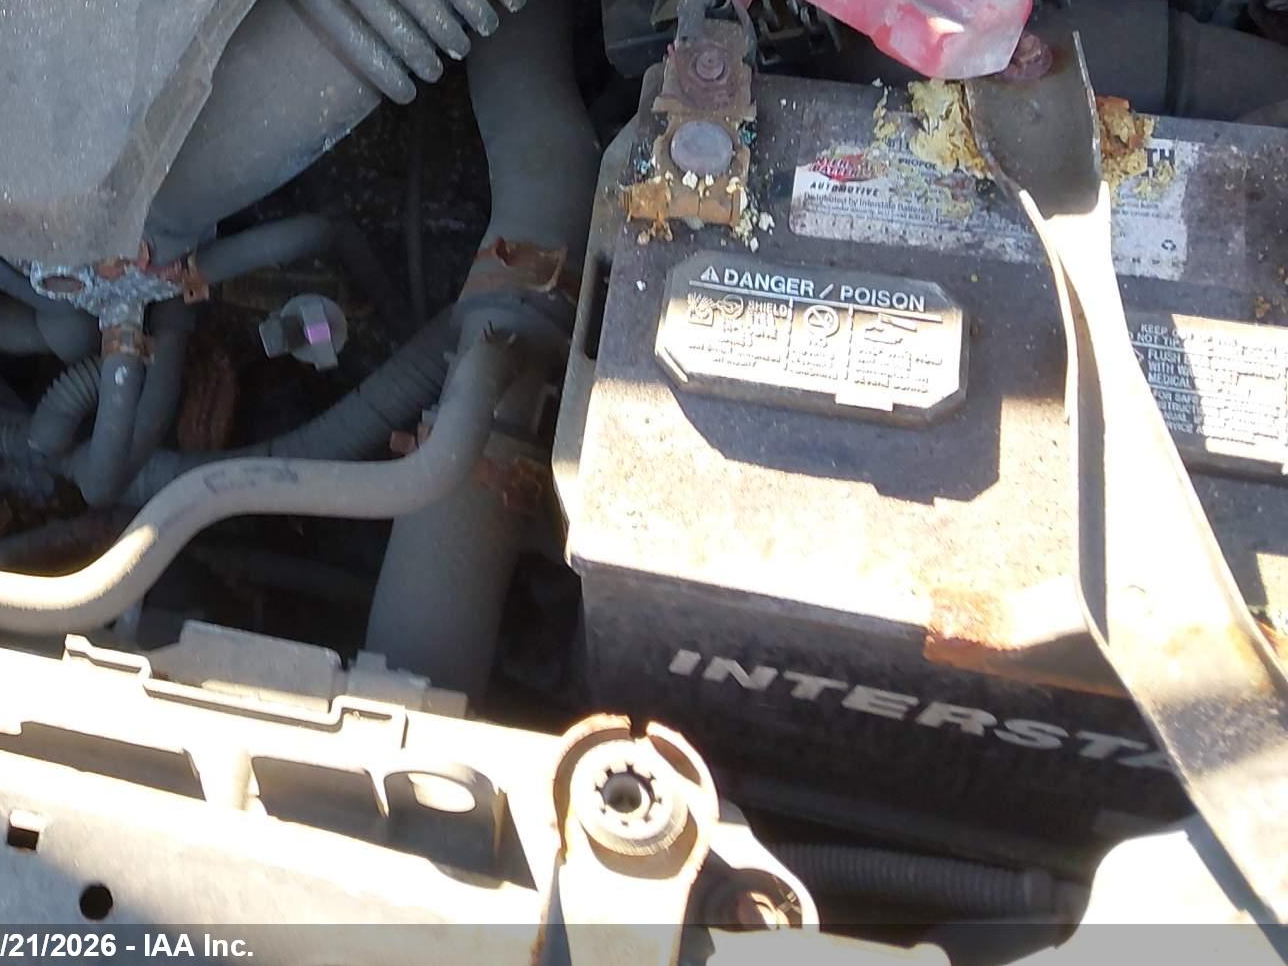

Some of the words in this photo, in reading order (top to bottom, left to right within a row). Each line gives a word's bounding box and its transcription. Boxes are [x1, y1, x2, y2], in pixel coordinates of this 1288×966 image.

[810, 180, 879, 197] AUTOMOTIVE
[724, 268, 815, 298] DANGER
[840, 285, 925, 314] POISON
[748, 300, 788, 319] SHIELD
[1141, 323, 1168, 336] KEEP
[1137, 333, 1159, 345] NOT
[1148, 349, 1181, 364] FLUSH
[1148, 361, 1175, 374] WITH
[1148, 372, 1191, 388] MEDICAL
